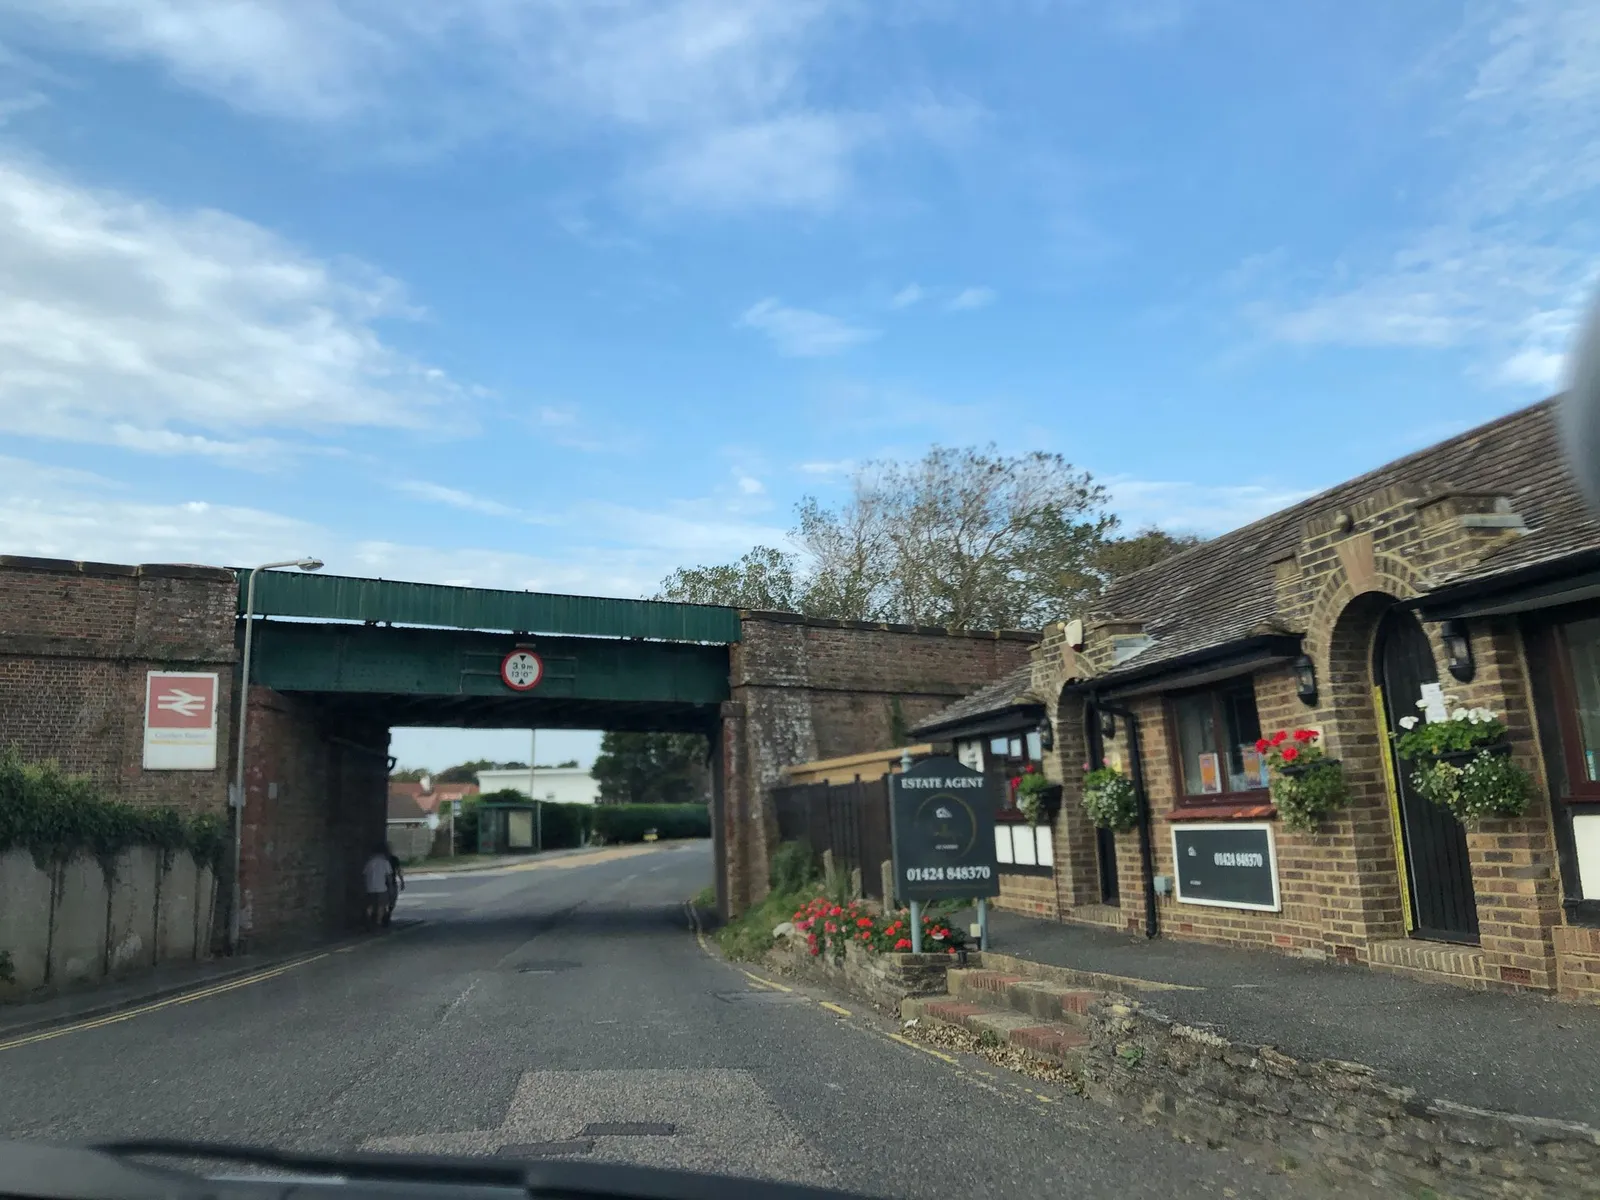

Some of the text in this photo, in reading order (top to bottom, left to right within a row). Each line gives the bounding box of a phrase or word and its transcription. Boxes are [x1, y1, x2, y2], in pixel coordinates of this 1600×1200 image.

[901, 777, 984, 788] ESTATE AGENT
[1214, 852, 1235, 866] 01424
[907, 866, 990, 881] 01424 848370
